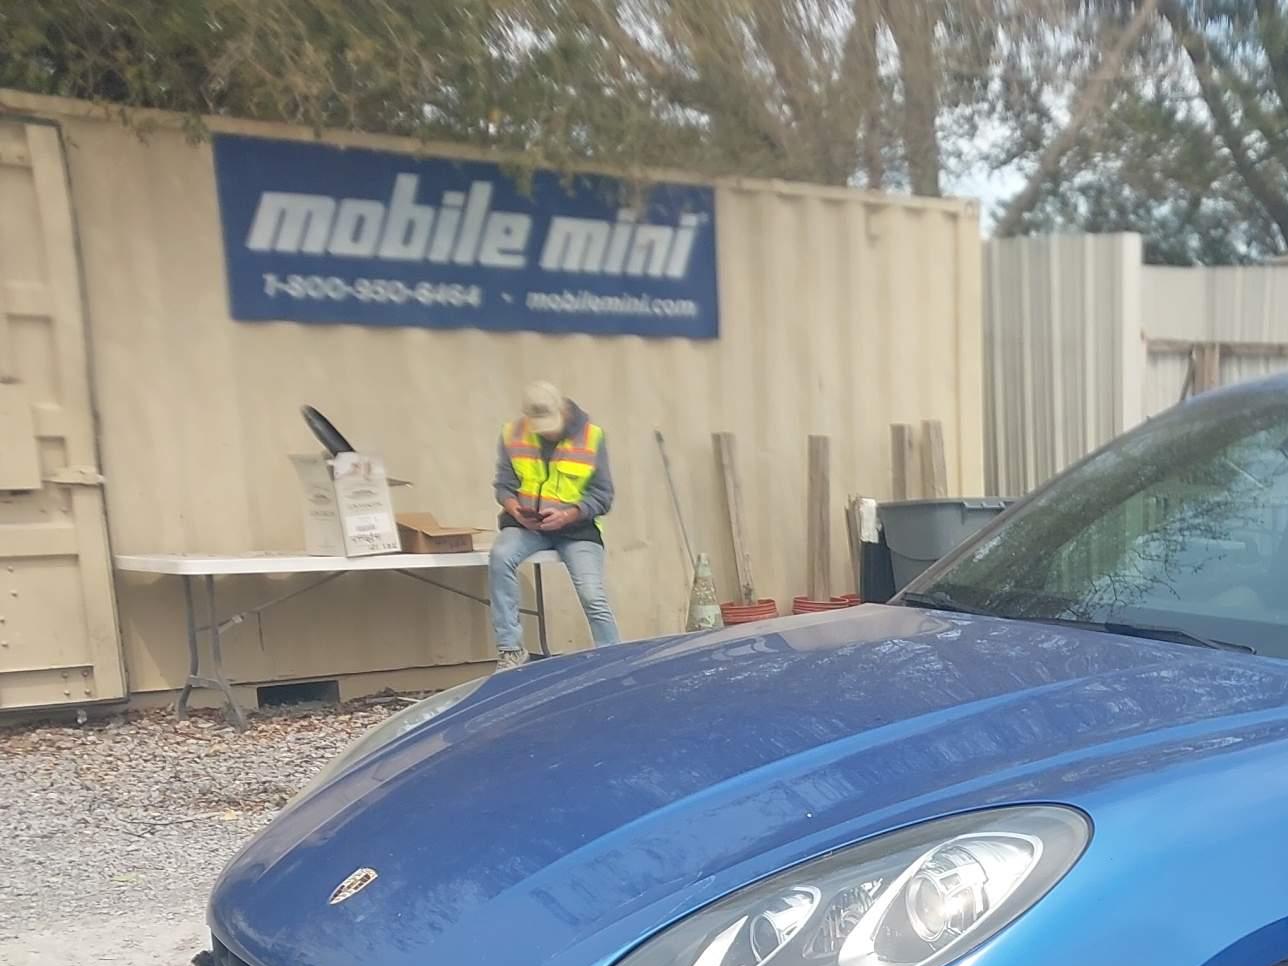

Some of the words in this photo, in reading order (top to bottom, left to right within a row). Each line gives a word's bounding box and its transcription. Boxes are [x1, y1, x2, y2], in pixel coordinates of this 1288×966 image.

[245, 172, 533, 269] mobile
[539, 208, 699, 280] mini
[526, 289, 698, 319] mobilemini.com
